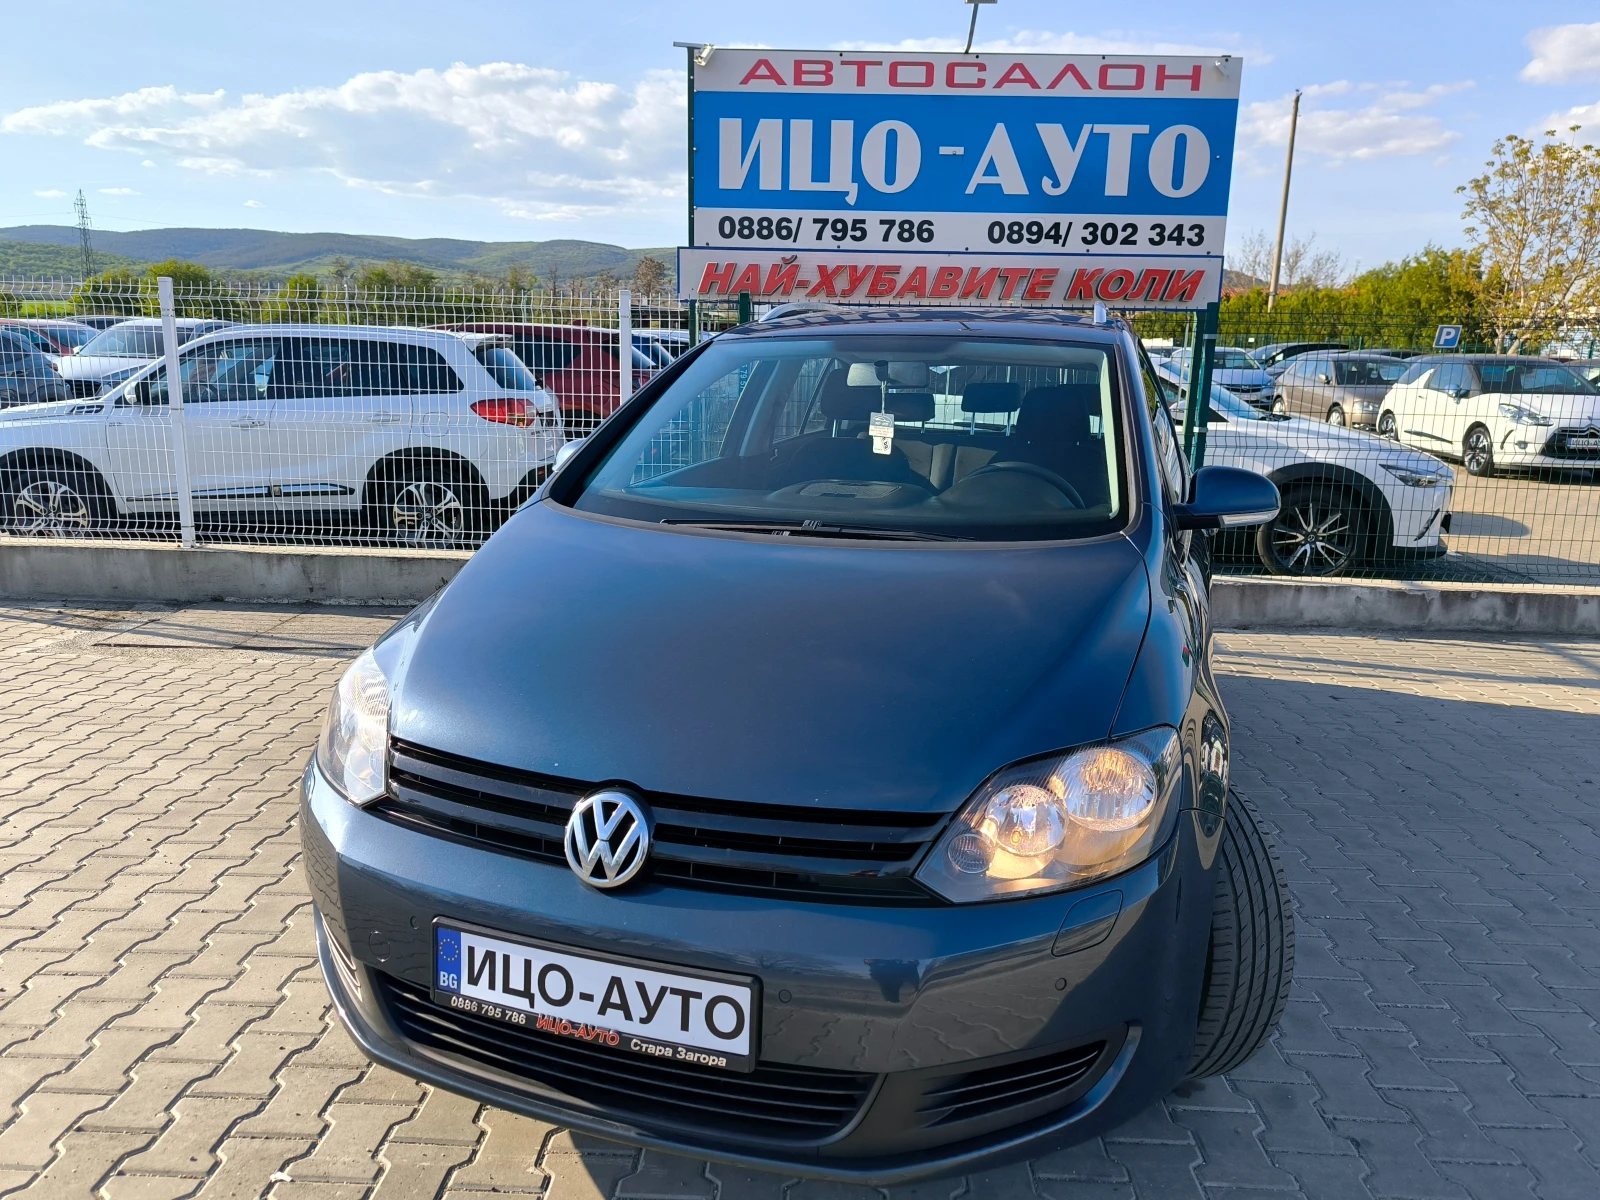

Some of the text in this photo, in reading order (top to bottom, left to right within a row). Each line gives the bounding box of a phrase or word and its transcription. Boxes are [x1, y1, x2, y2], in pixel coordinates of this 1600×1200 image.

[739, 59, 1202, 92] АВТОСАЛОН
[718, 215, 935, 243] 0886/ 795 786
[987, 220, 1205, 247] 0894/ 302 343
[697, 254, 1206, 302] НАЙ-ХУБАВИТЕ КОЛИ
[1439, 327, 1456, 345] P
[571, 798, 643, 882] VW
[439, 971, 458, 989] BG
[467, 945, 746, 1041] ИЦО-АУТО
[450, 995, 526, 1025] 0886 795 786
[536, 1014, 620, 1046] ИЦО-АУТО
[630, 1038, 727, 1067] Стара Загора
